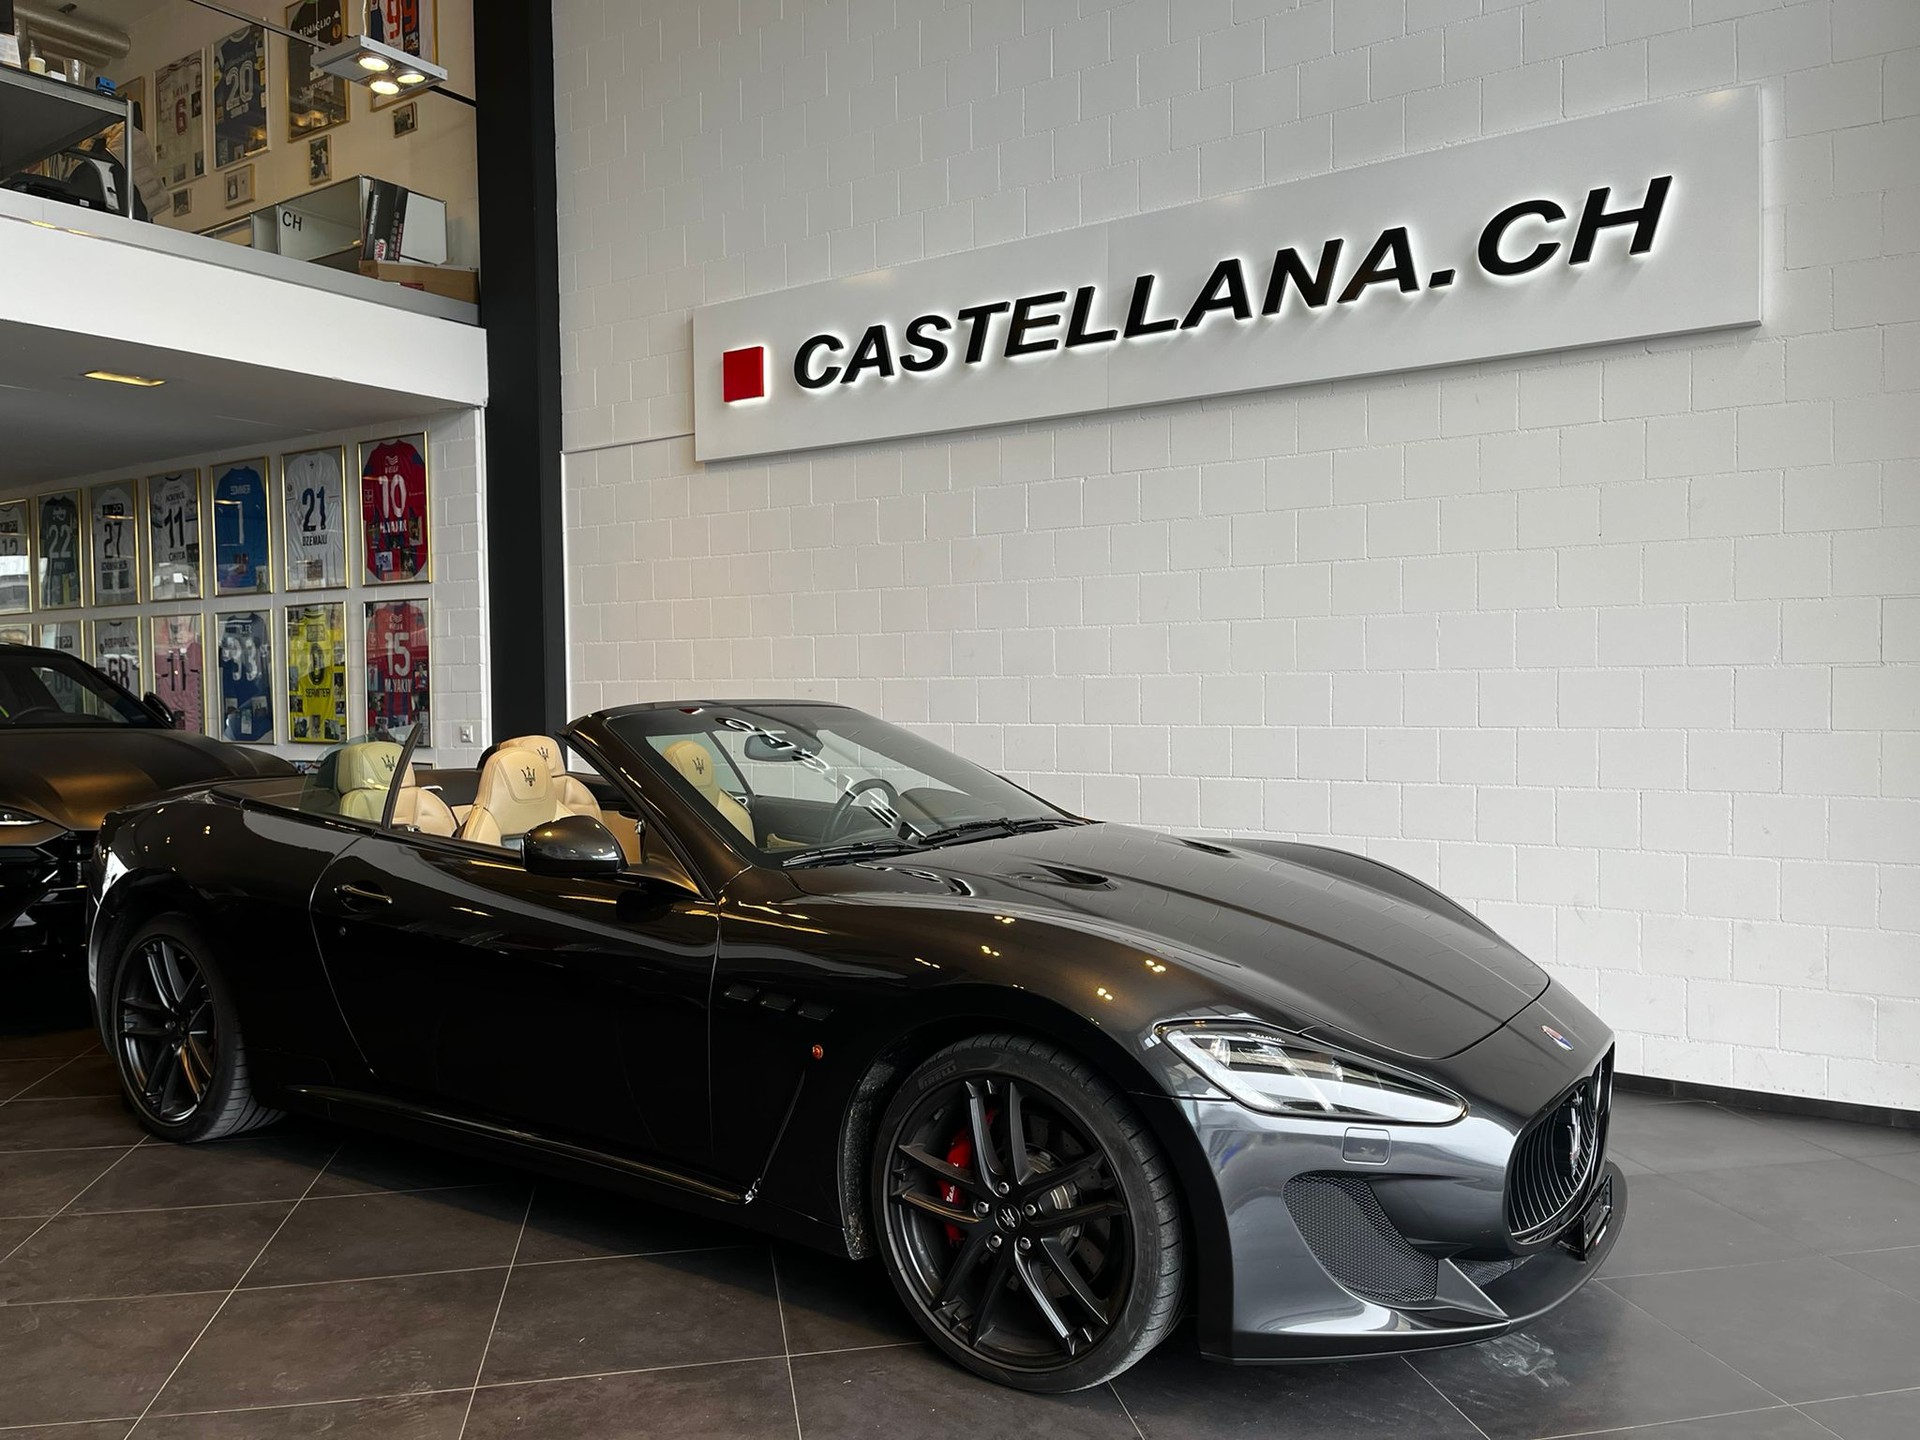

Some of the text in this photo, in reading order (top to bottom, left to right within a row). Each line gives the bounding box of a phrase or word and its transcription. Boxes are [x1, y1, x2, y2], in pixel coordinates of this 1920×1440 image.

[225, 60, 254, 111] 20
[282, 211, 302, 231] CH
[794, 175, 1672, 388] CASTELLANA.CH
[302, 486, 326, 533] 21
[378, 473, 407, 519] 10
[49, 524, 72, 559] 22
[104, 521, 122, 559] 27
[164, 506, 184, 549] 11
[384, 632, 411, 676] 15
